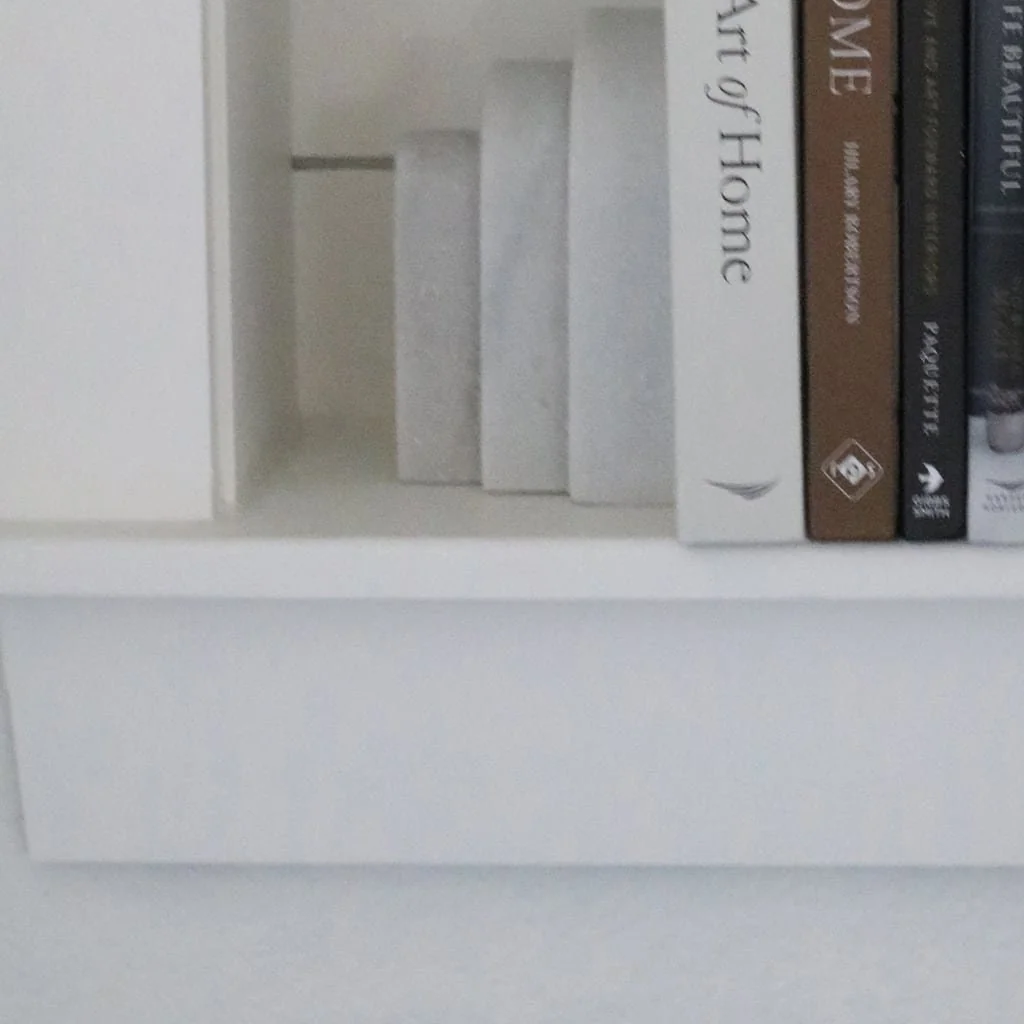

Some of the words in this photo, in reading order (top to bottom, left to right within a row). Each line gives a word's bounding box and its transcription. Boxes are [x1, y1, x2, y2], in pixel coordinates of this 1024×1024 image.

[703, 75, 762, 125] of
[1000, 43, 1023, 196] BEAUTIFUL
[719, 129, 763, 286] Home
[919, 320, 940, 437] PAQUETTE
